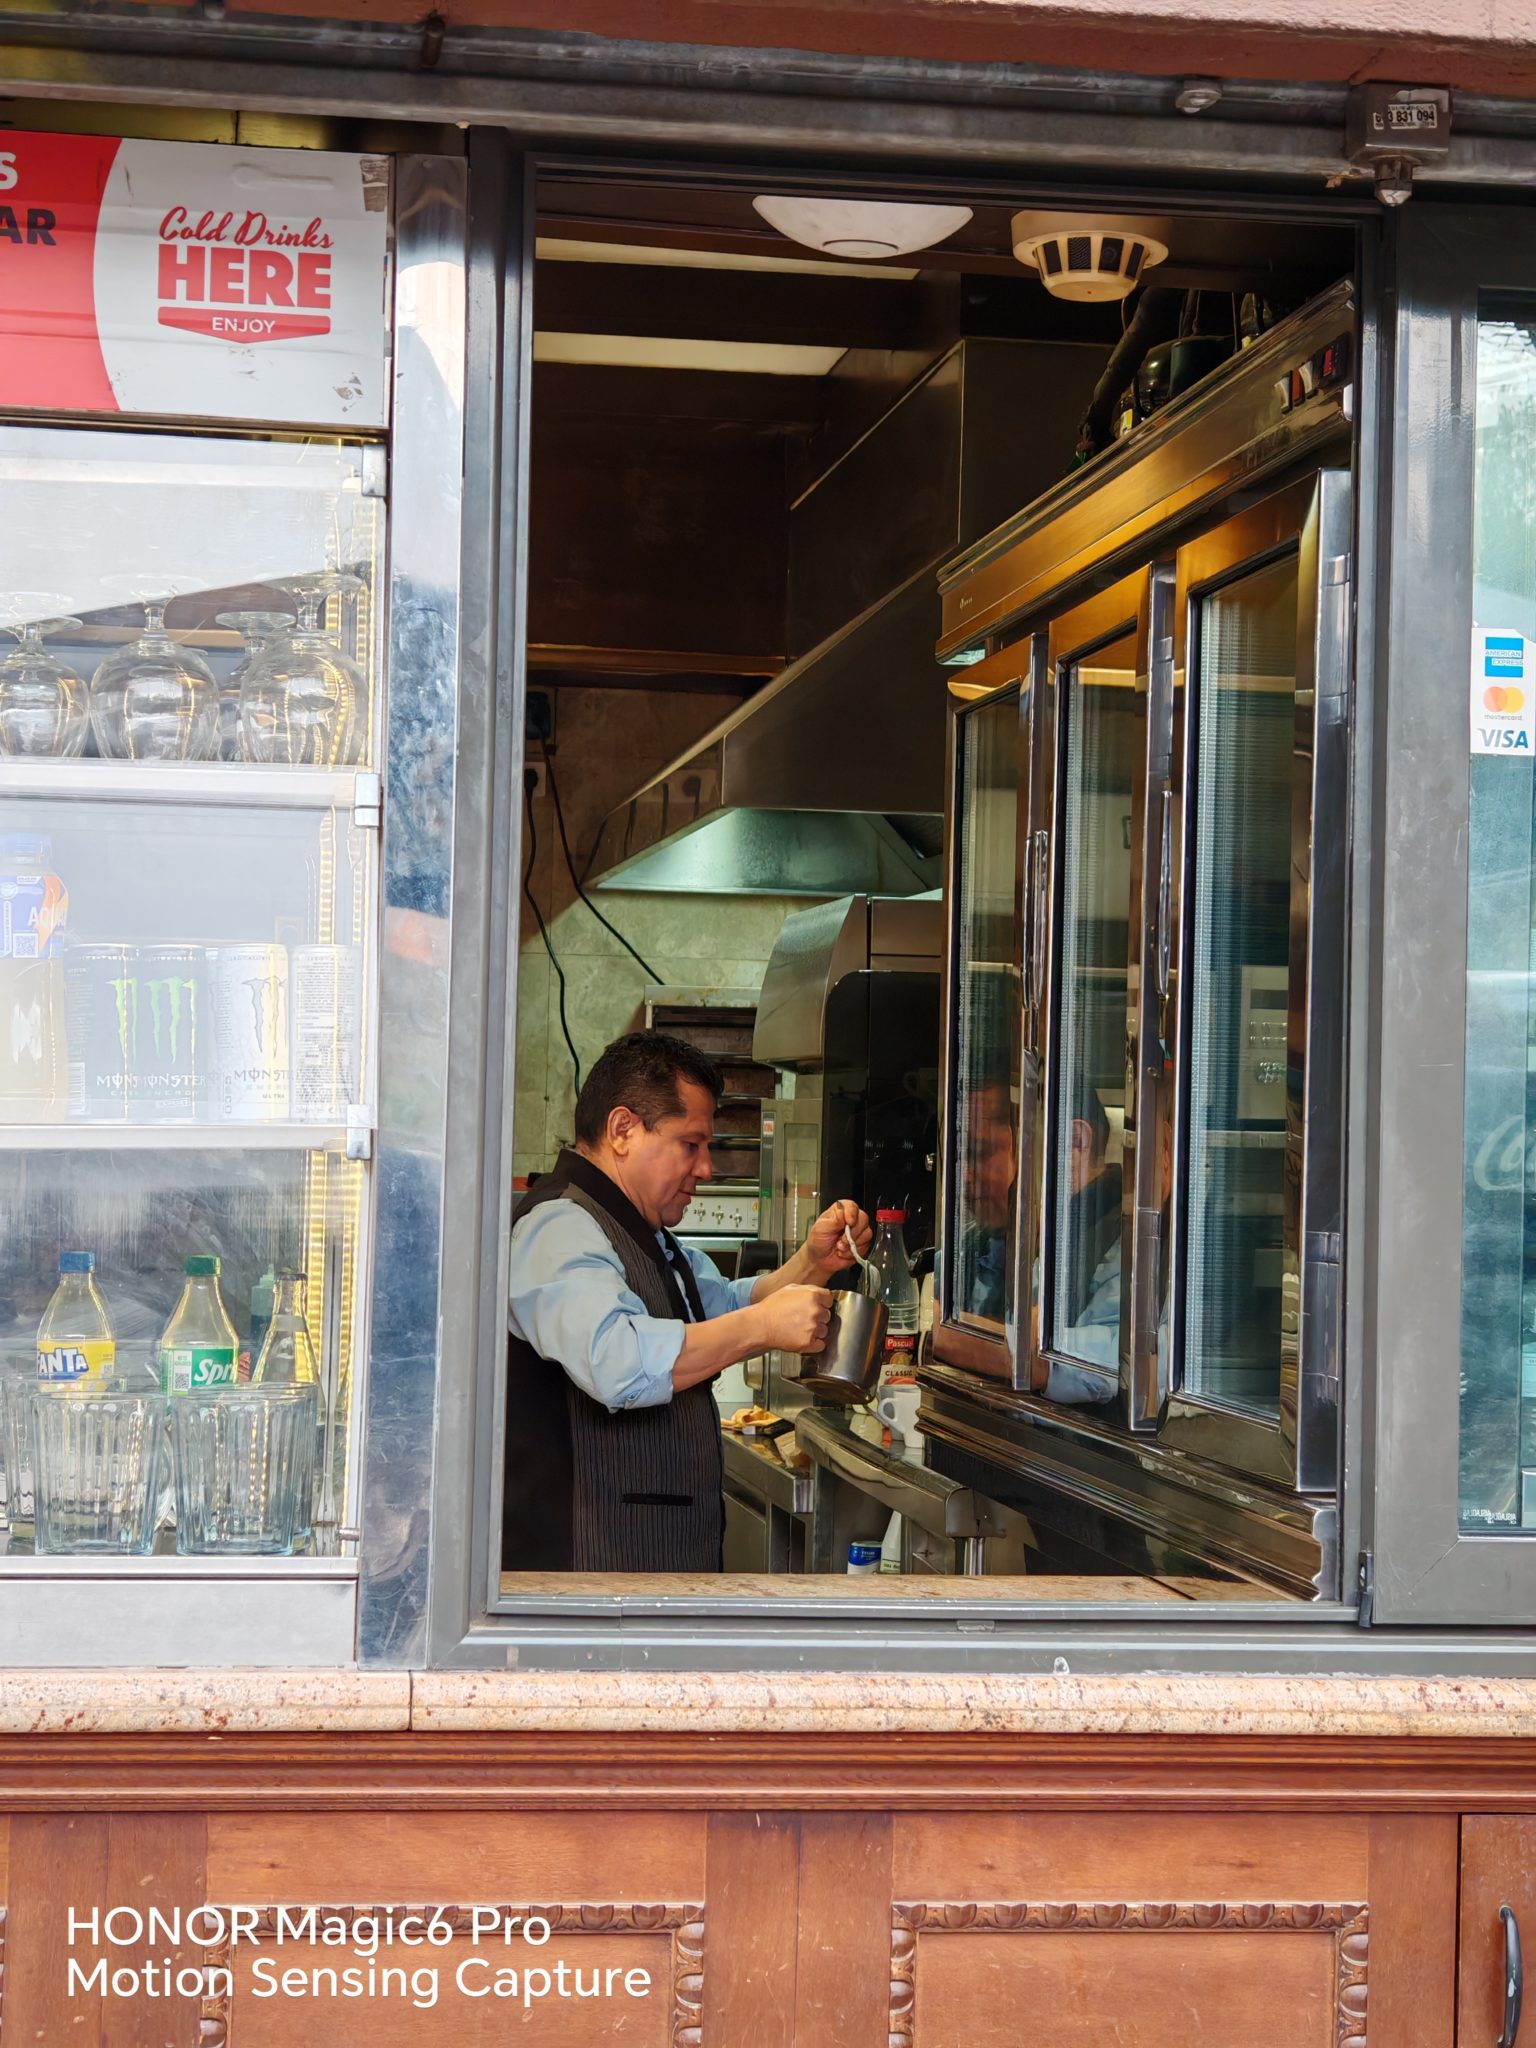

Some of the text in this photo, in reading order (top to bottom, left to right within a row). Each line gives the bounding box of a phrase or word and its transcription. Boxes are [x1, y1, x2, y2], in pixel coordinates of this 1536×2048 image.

[1417, 110, 1435, 121] 094
[159, 206, 334, 249] Cold Drinks
[158, 243, 331, 309] HERE
[212, 316, 276, 334] ENJOY
[1477, 728, 1529, 749] VISA
[37, 1347, 87, 1374] ANTA
